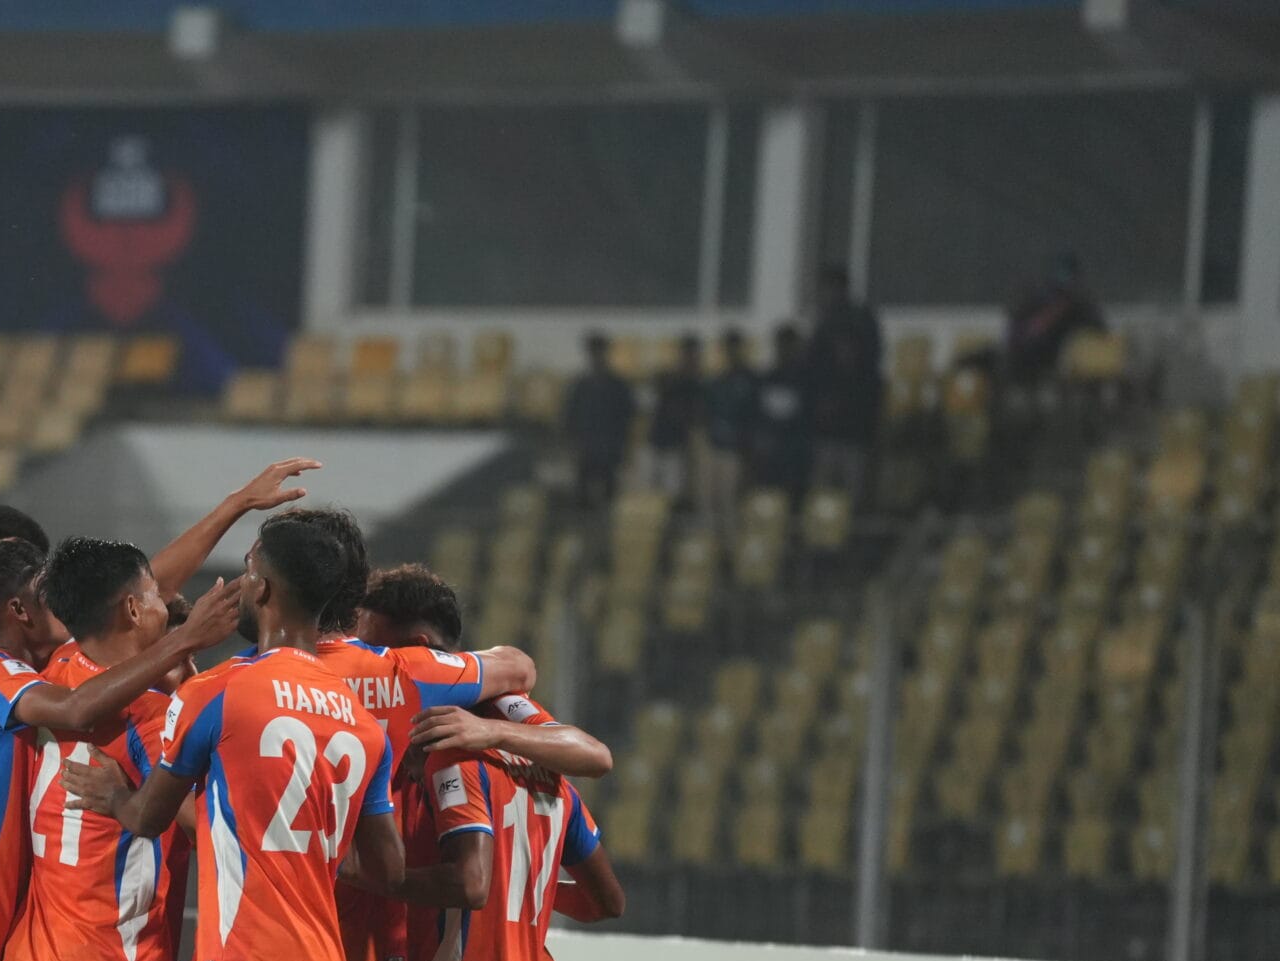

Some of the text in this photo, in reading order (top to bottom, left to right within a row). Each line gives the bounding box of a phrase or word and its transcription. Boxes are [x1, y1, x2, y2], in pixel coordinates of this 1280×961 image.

[271, 679, 356, 726] HARSH
[260, 715, 367, 863] 23
[438, 778, 460, 793] AFC
[503, 786, 564, 926] 17
